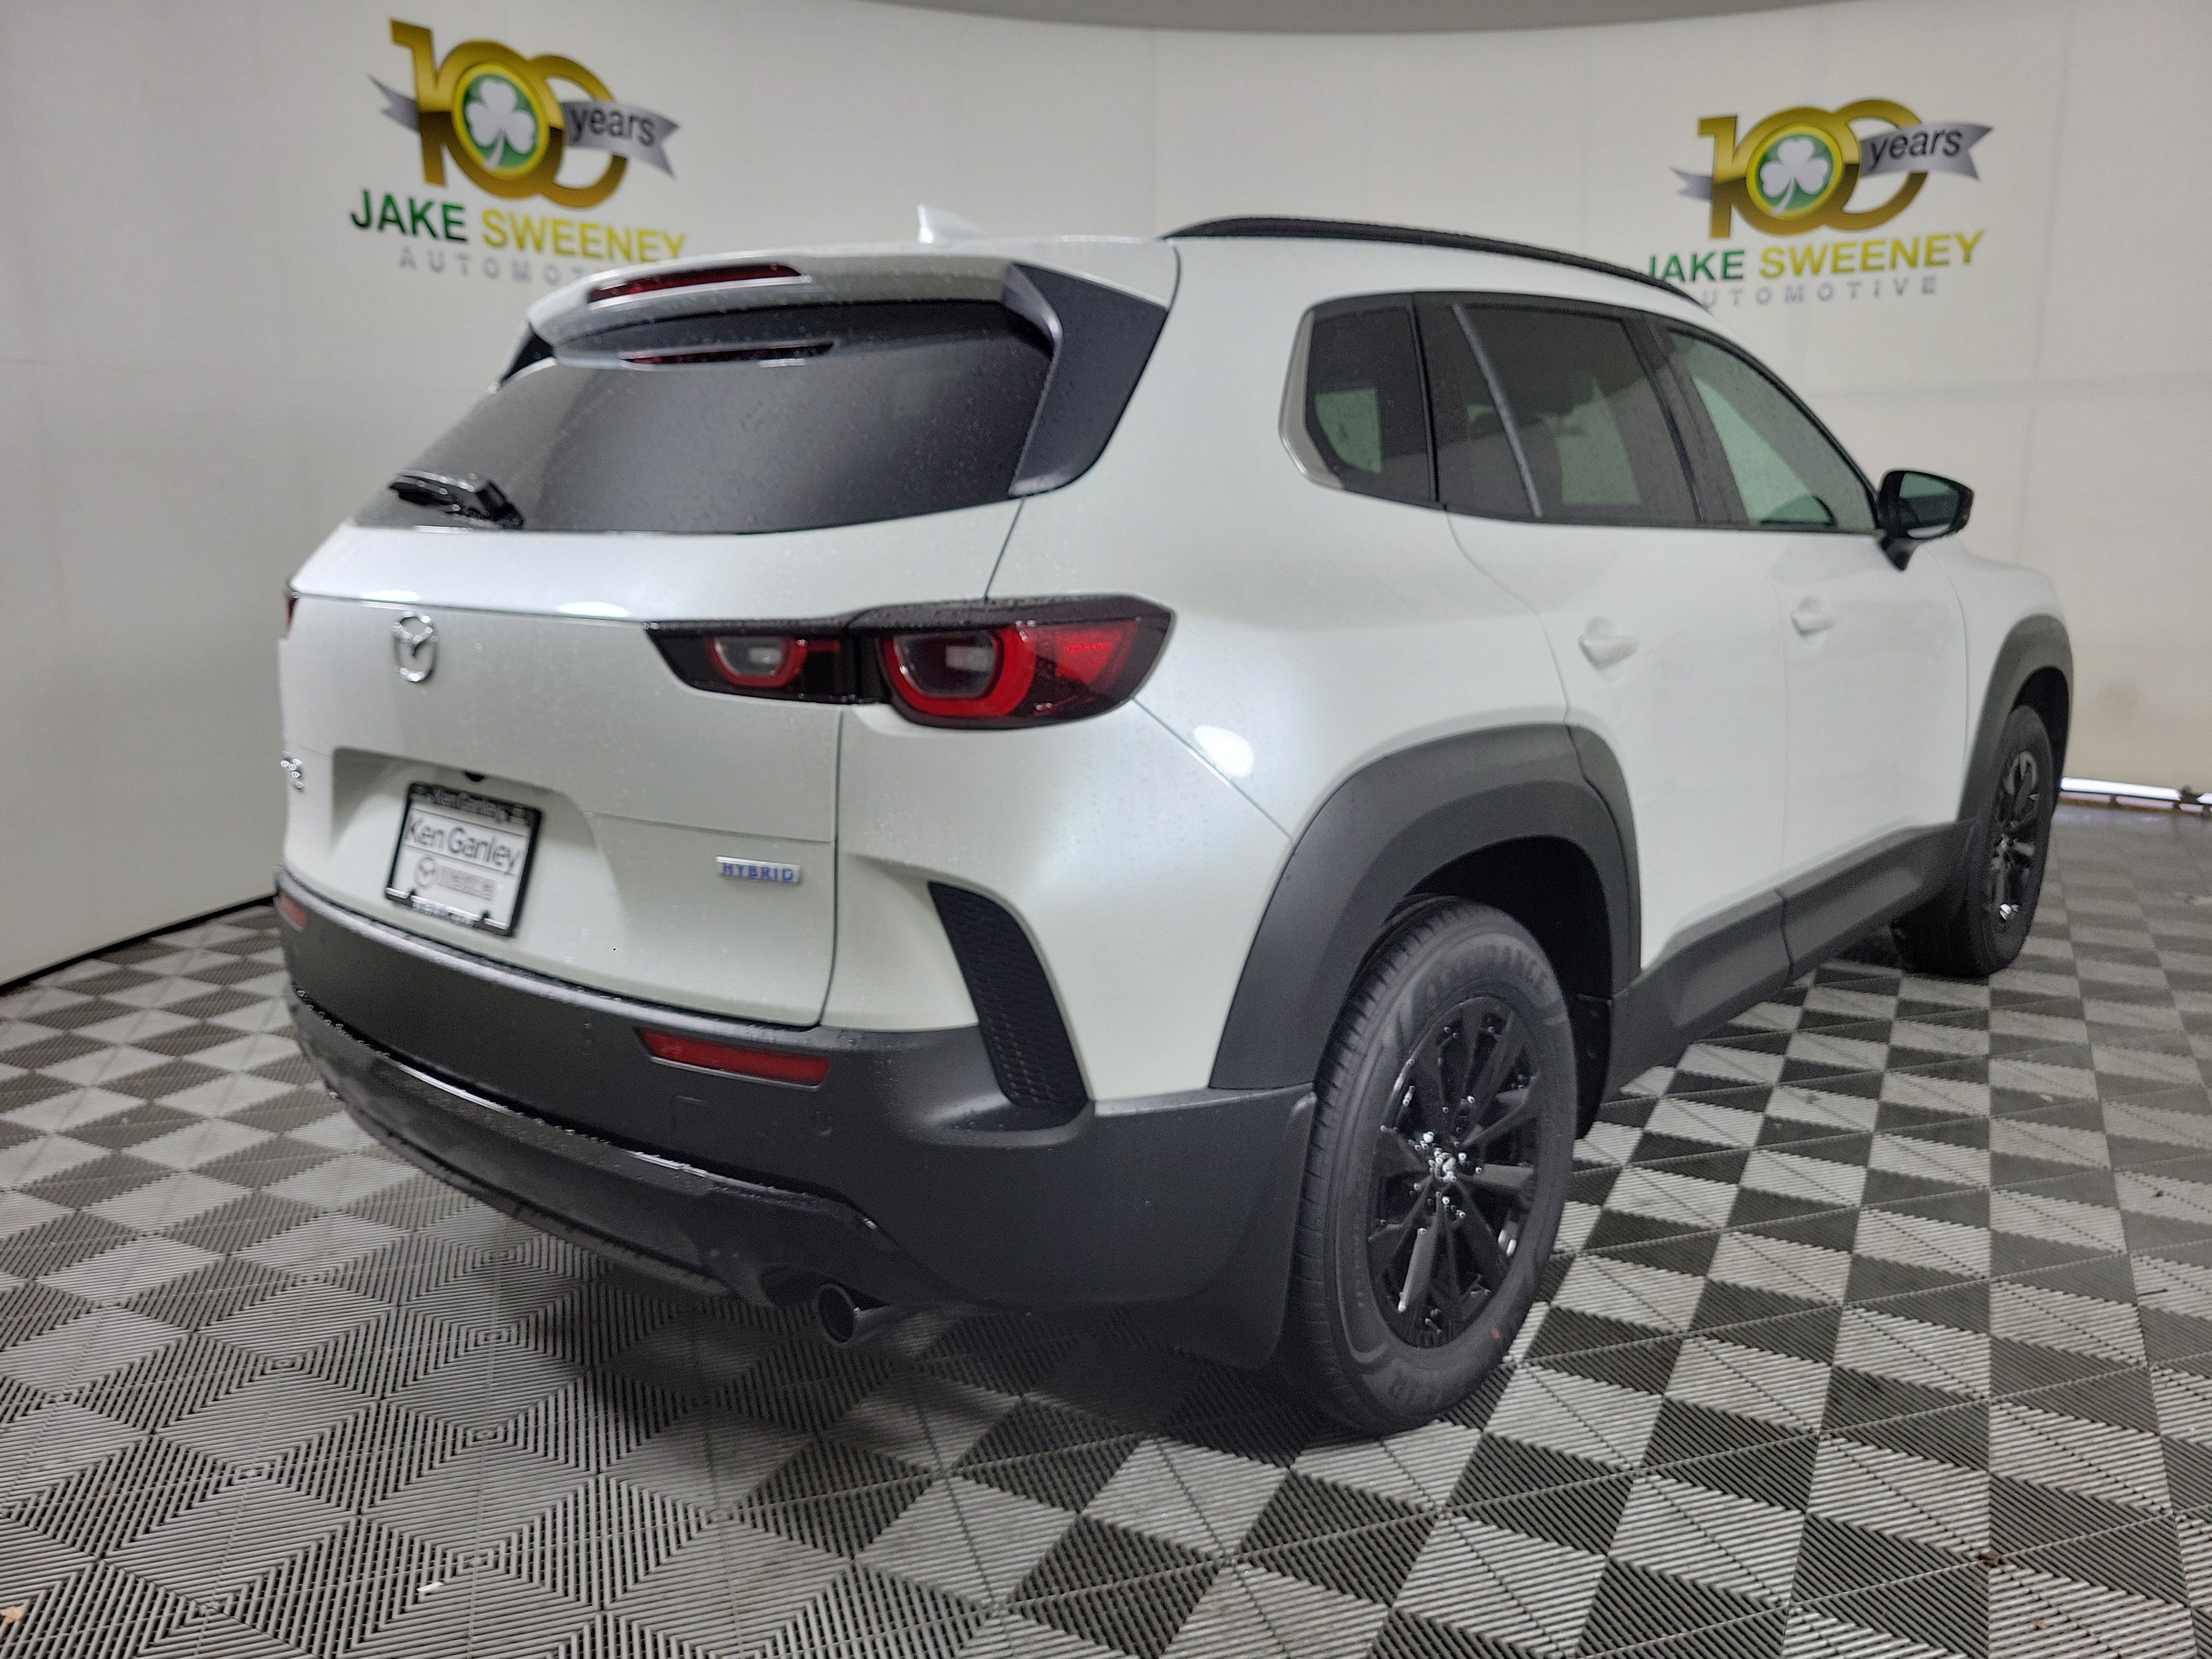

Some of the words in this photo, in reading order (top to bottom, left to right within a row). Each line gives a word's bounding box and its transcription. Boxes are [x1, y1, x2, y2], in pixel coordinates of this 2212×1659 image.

[389, 18, 630, 212] 100
[572, 105, 656, 147] years
[1697, 98, 1928, 240] 100
[1870, 126, 1962, 171] years
[350, 188, 469, 243] JAKE
[481, 207, 687, 264] SWEENEY
[399, 245, 585, 286] AUTOMO
[1758, 230, 1985, 279] SWEENEY
[1701, 276, 1938, 310] UTOMOTIVE
[411, 817, 445, 850] Ken
[447, 826, 520, 875] Ganley
[722, 862, 794, 883] HYBRID
